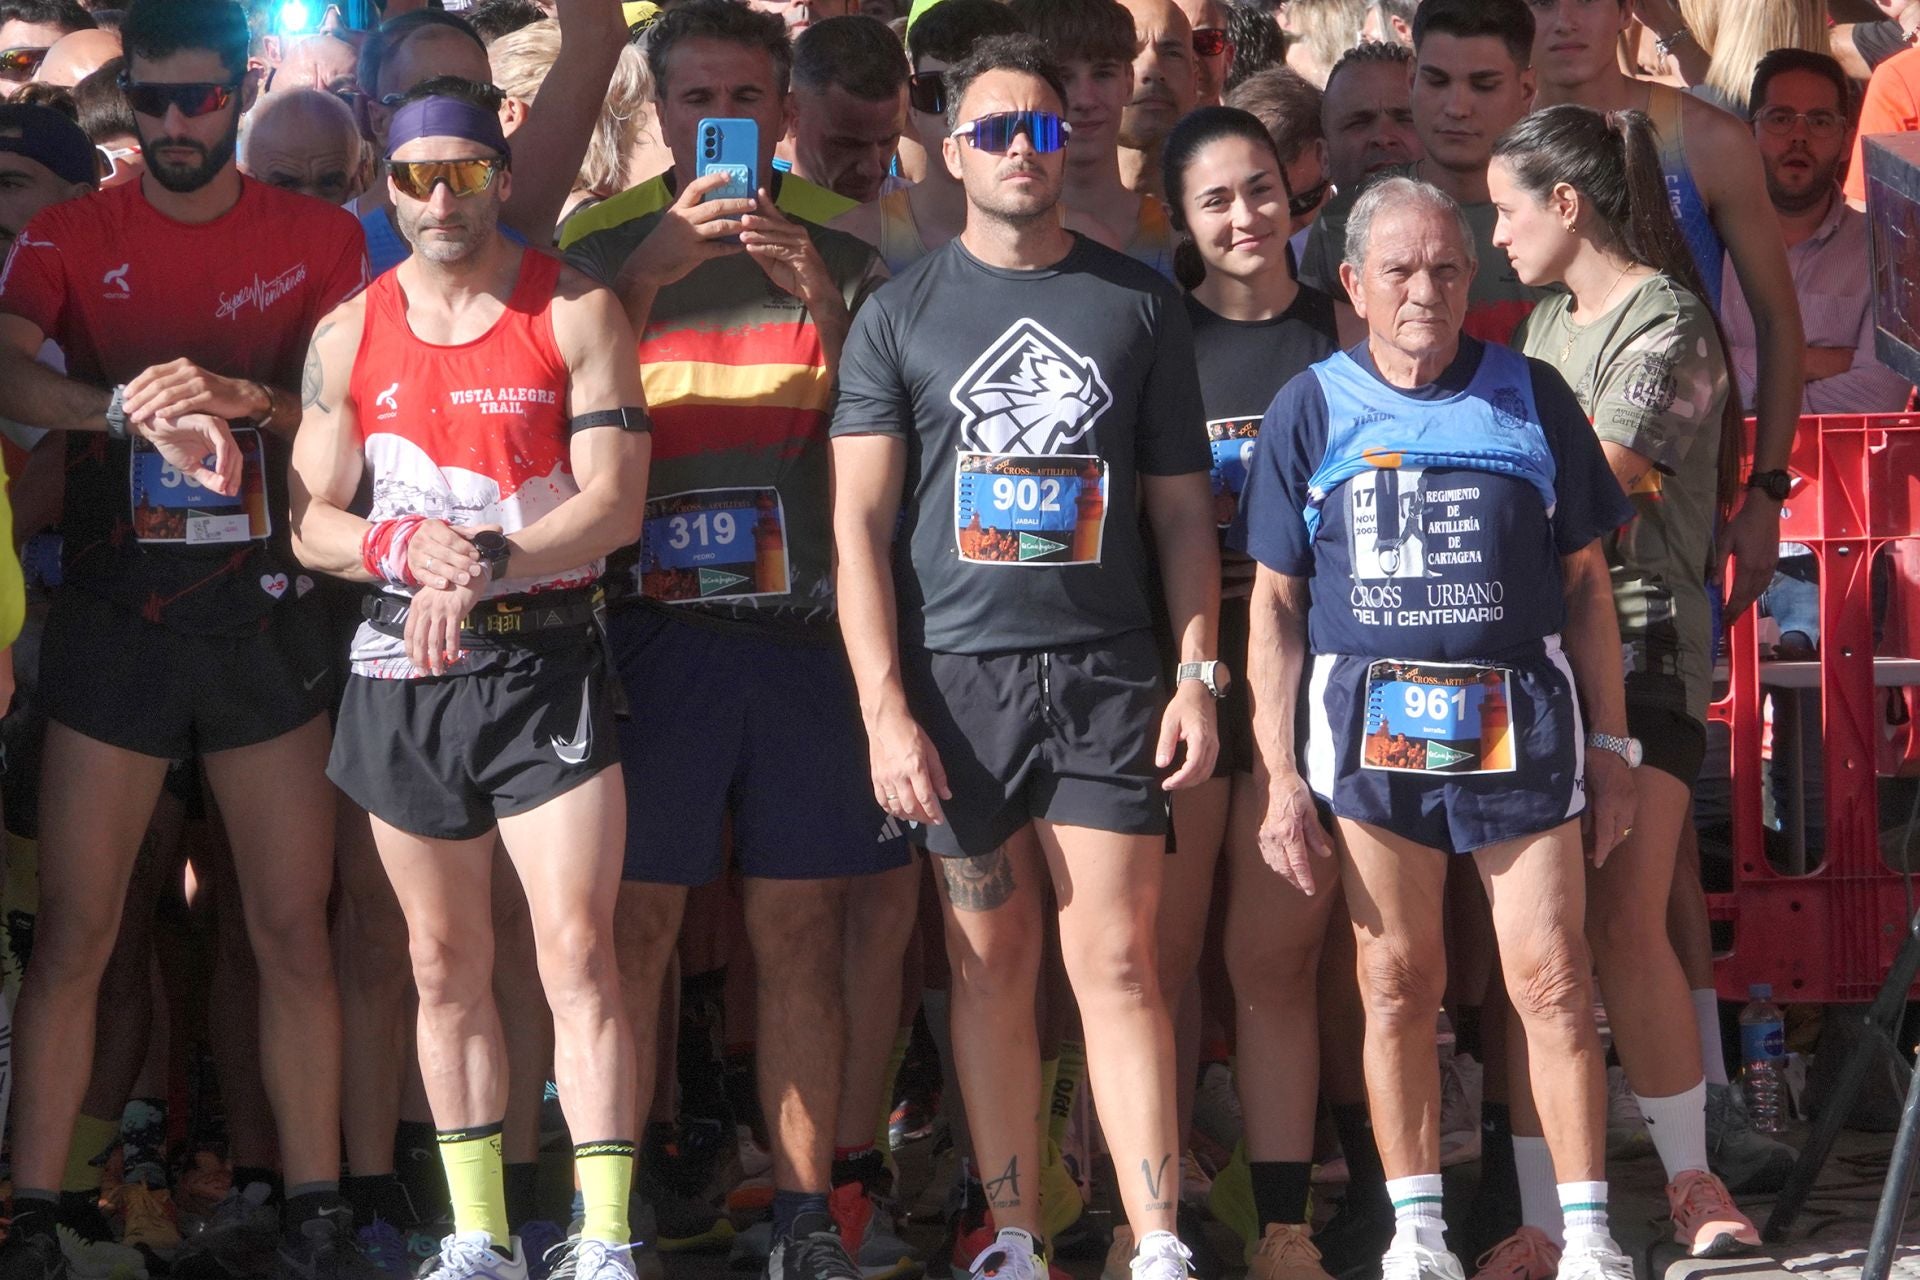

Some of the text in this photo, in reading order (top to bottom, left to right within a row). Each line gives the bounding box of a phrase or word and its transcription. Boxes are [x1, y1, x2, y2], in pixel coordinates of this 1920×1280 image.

[450, 387, 556, 405] VISTA ALEGRE
[480, 402, 524, 415] TRAIL
[1003, 466, 1030, 475] CROSS
[992, 477, 1061, 512] 902
[1353, 487, 1375, 508] 17
[1426, 487, 1480, 503] REGIMIENTO
[1356, 514, 1375, 523] NOV
[1447, 505, 1460, 517] DE
[668, 511, 737, 550] 319
[1355, 526, 1378, 535] 2002
[1428, 516, 1480, 534] ARTILLERÍA
[1448, 536, 1461, 549] DE
[1428, 550, 1482, 565] CARTAGENA
[1350, 581, 1504, 609] CROSS URBANO
[1353, 606, 1504, 626] DEL II CENTENARIO
[1412, 675, 1438, 684] CROSS
[1404, 685, 1466, 721] 961
[986, 1153, 1172, 1200] A V
